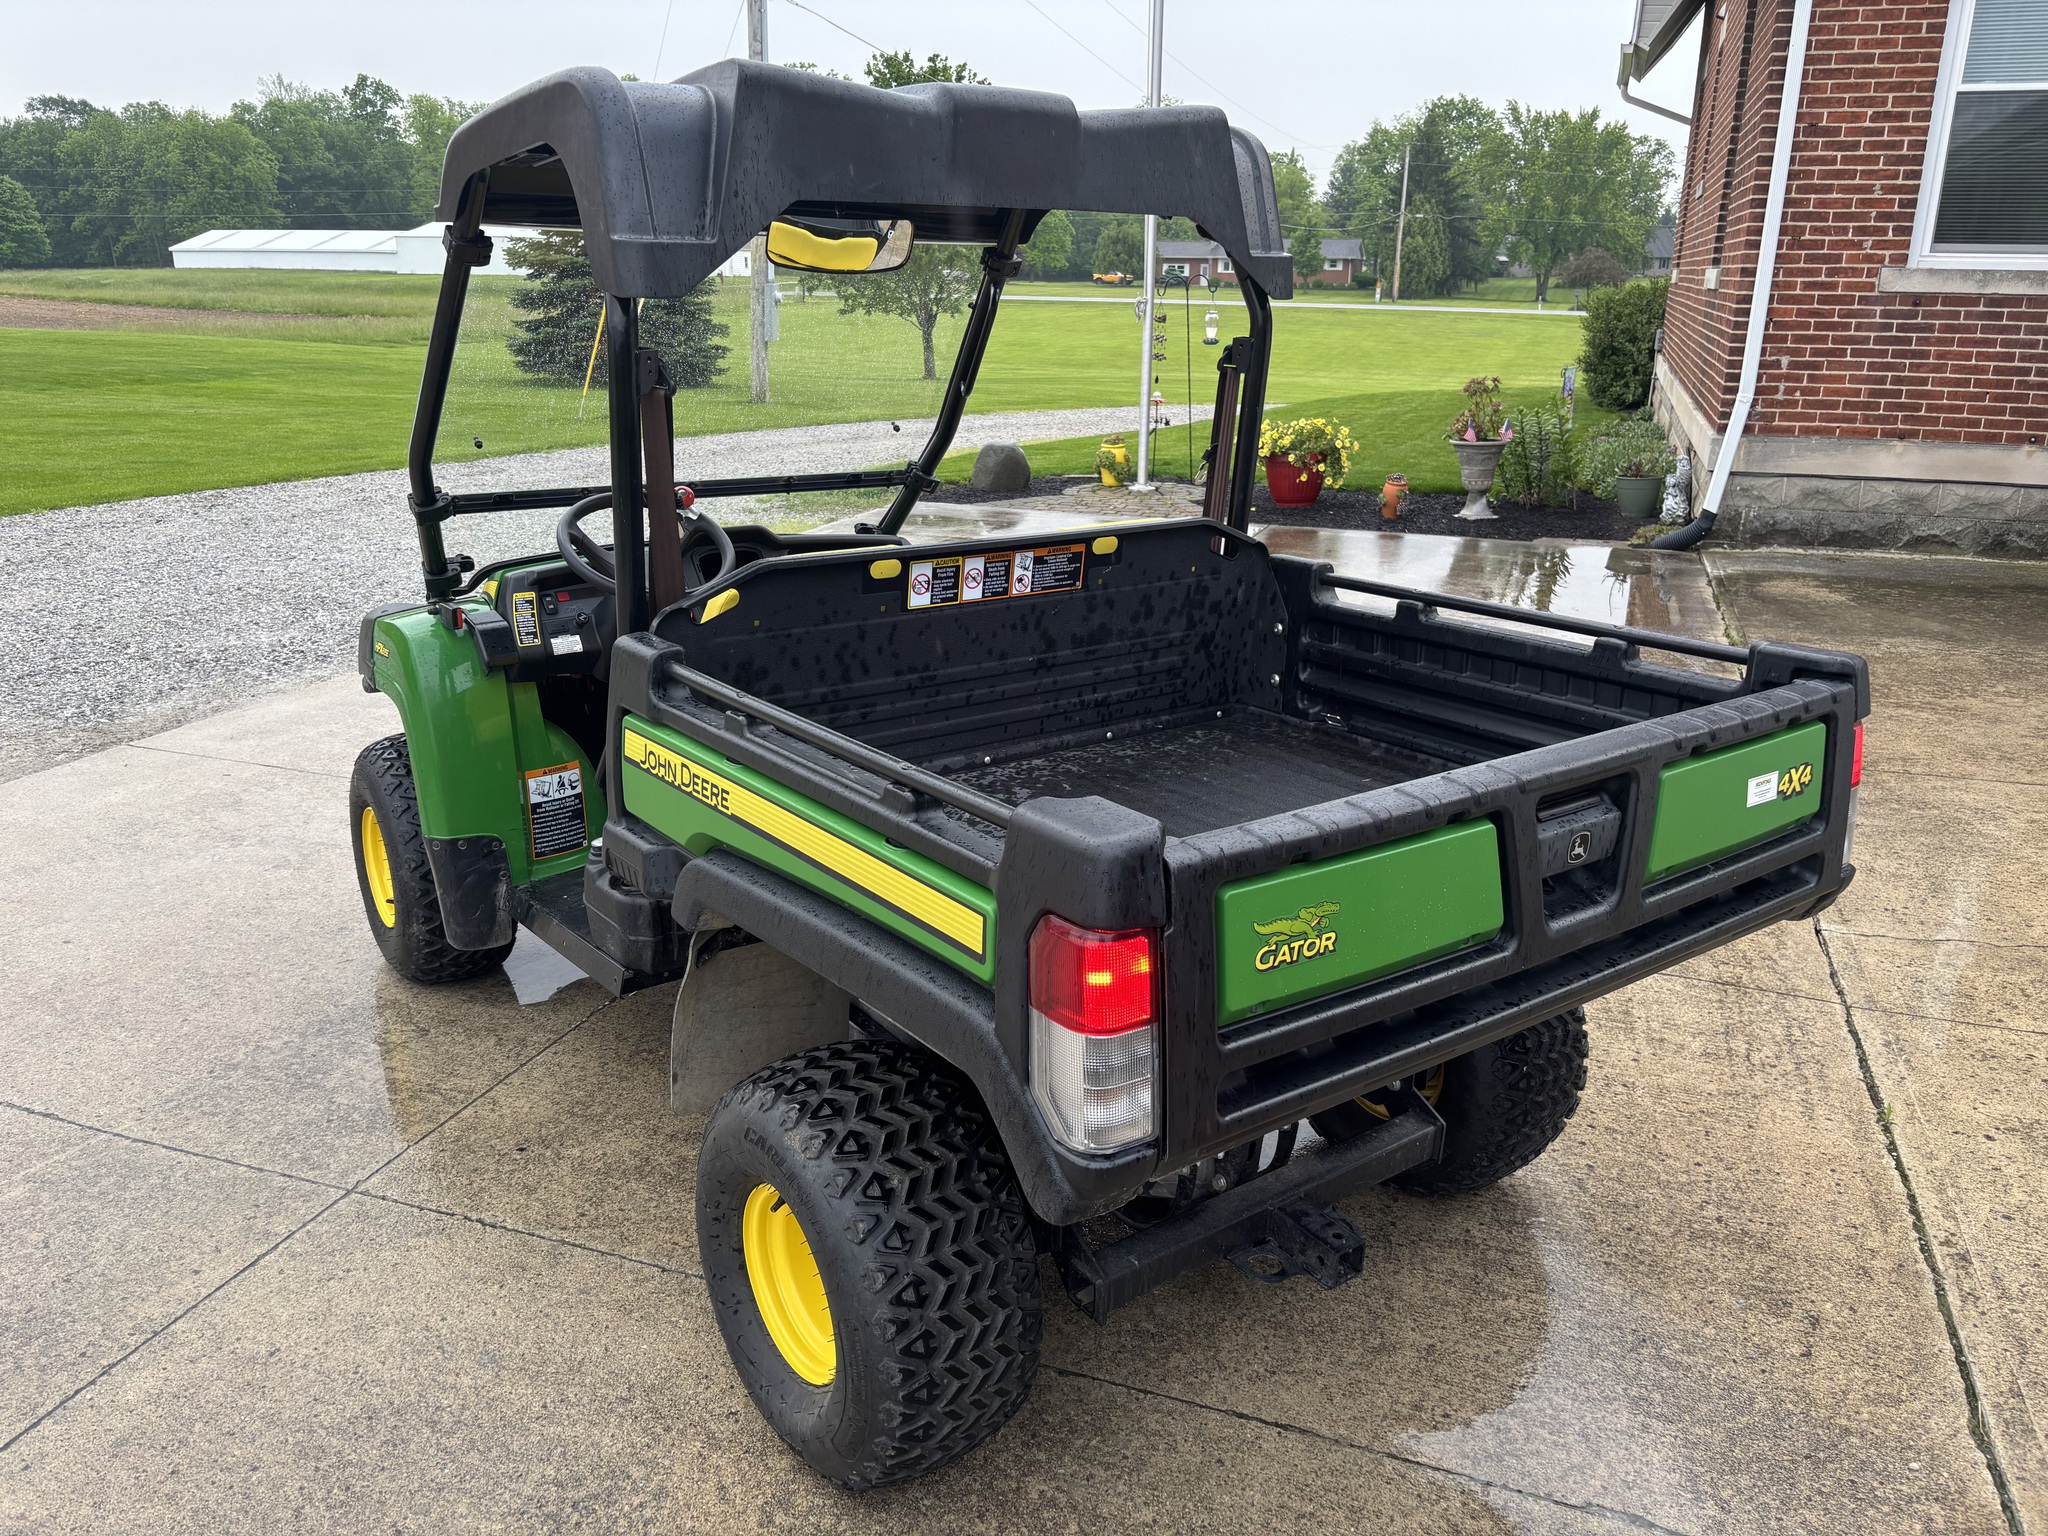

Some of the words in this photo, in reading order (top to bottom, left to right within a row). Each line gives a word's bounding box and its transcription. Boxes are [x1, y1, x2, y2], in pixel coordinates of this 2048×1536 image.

[548, 765, 568, 774] WARNING
[640, 743, 677, 783] JOHN
[680, 762, 730, 811] DEERE
[1778, 763, 1812, 798] 4X4
[1255, 931, 1337, 972] GATOR
